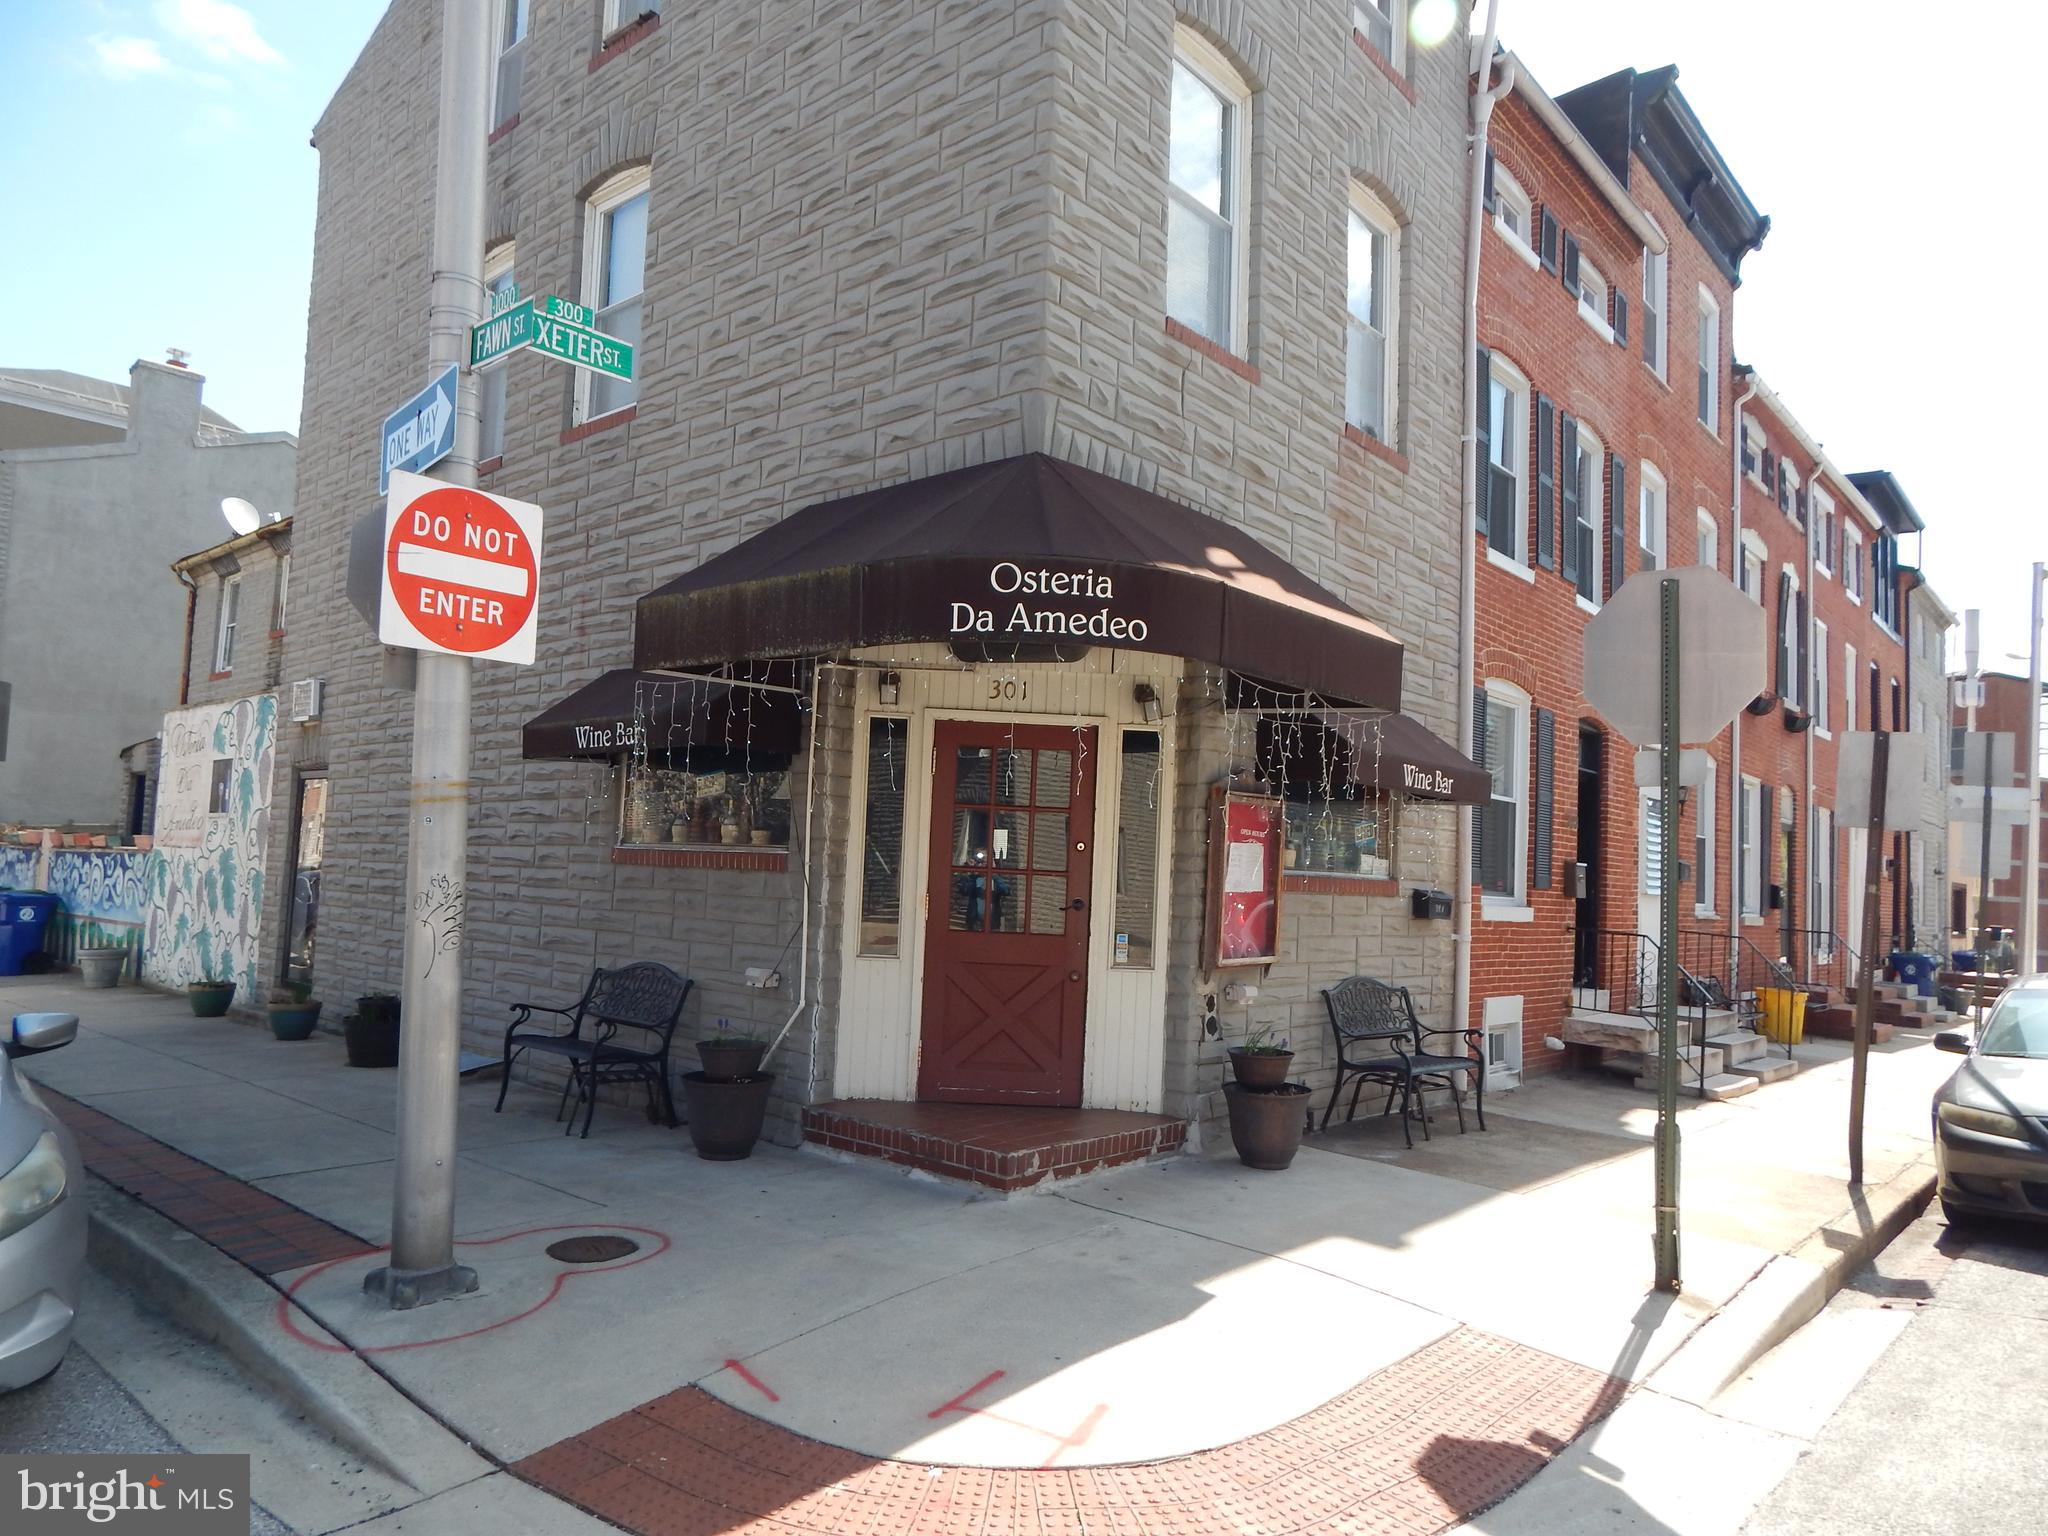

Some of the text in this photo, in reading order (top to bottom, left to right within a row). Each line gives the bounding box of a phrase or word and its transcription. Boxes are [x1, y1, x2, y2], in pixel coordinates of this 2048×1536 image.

[554, 299, 584, 324] 300
[476, 314, 526, 360] FAWN ST.
[533, 317, 622, 368] XETER ST.
[389, 404, 438, 465] ONE WAY
[413, 510, 519, 557] DO NOT
[990, 562, 1114, 599] Osteria
[419, 587, 505, 626] ENTER
[950, 602, 1149, 642] Da Amedeo
[988, 679, 1028, 701] 301
[575, 722, 640, 749] Wine Bar
[1403, 763, 1454, 794] Wine Bar
